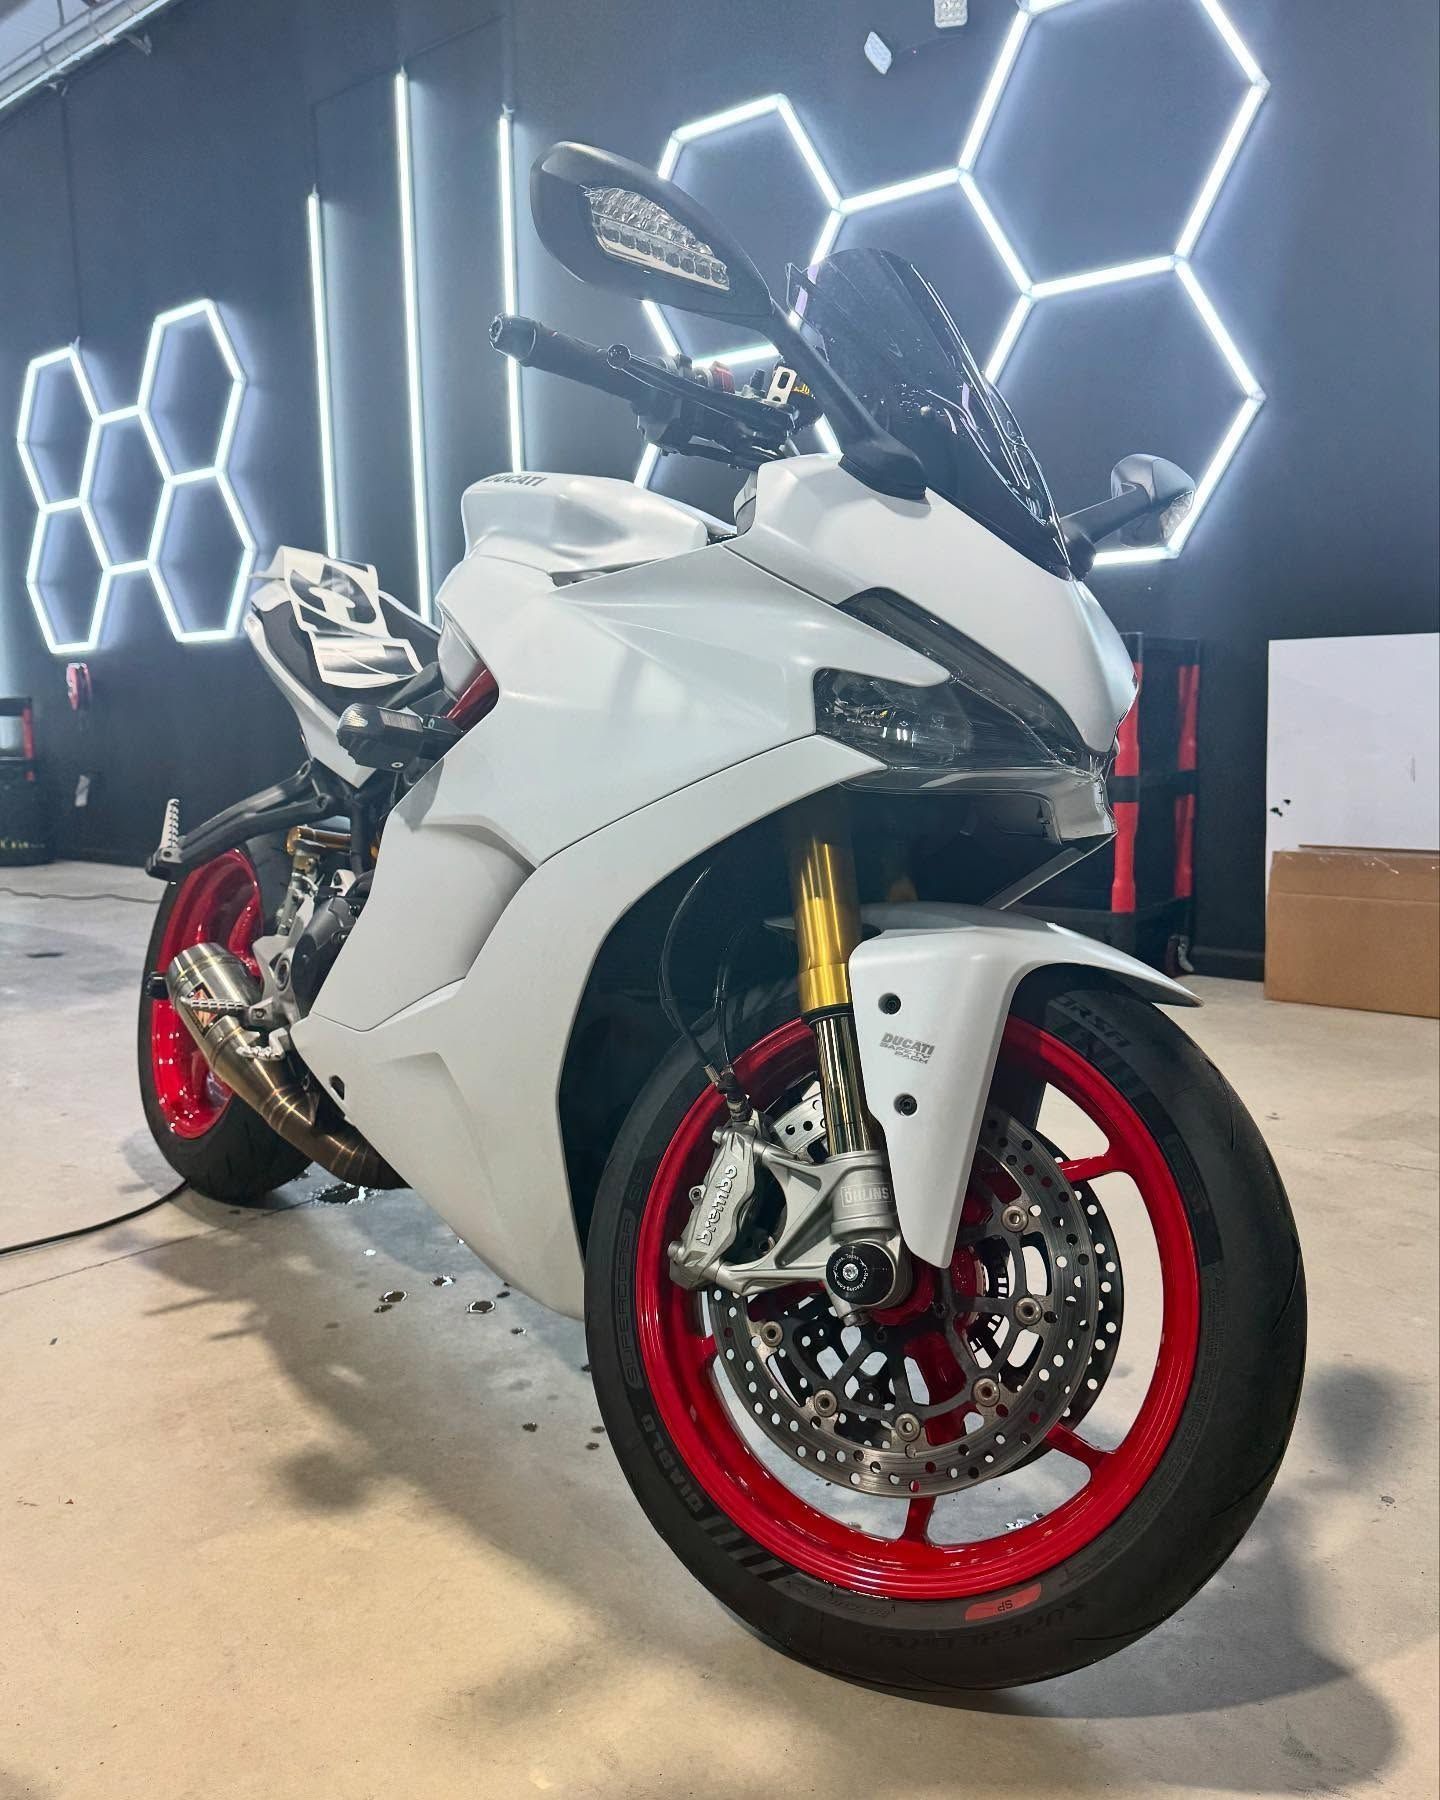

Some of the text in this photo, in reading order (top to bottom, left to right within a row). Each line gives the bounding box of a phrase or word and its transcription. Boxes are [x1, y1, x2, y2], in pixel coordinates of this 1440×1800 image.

[879, 1041, 931, 1059] SAFETY
[881, 1032, 935, 1055] DUCATI
[844, 1186, 889, 1203] ÖHLINS
[697, 1164, 738, 1247] brembo
[641, 1413, 705, 1513] DIABLO
[997, 1599, 1014, 1613] SP
